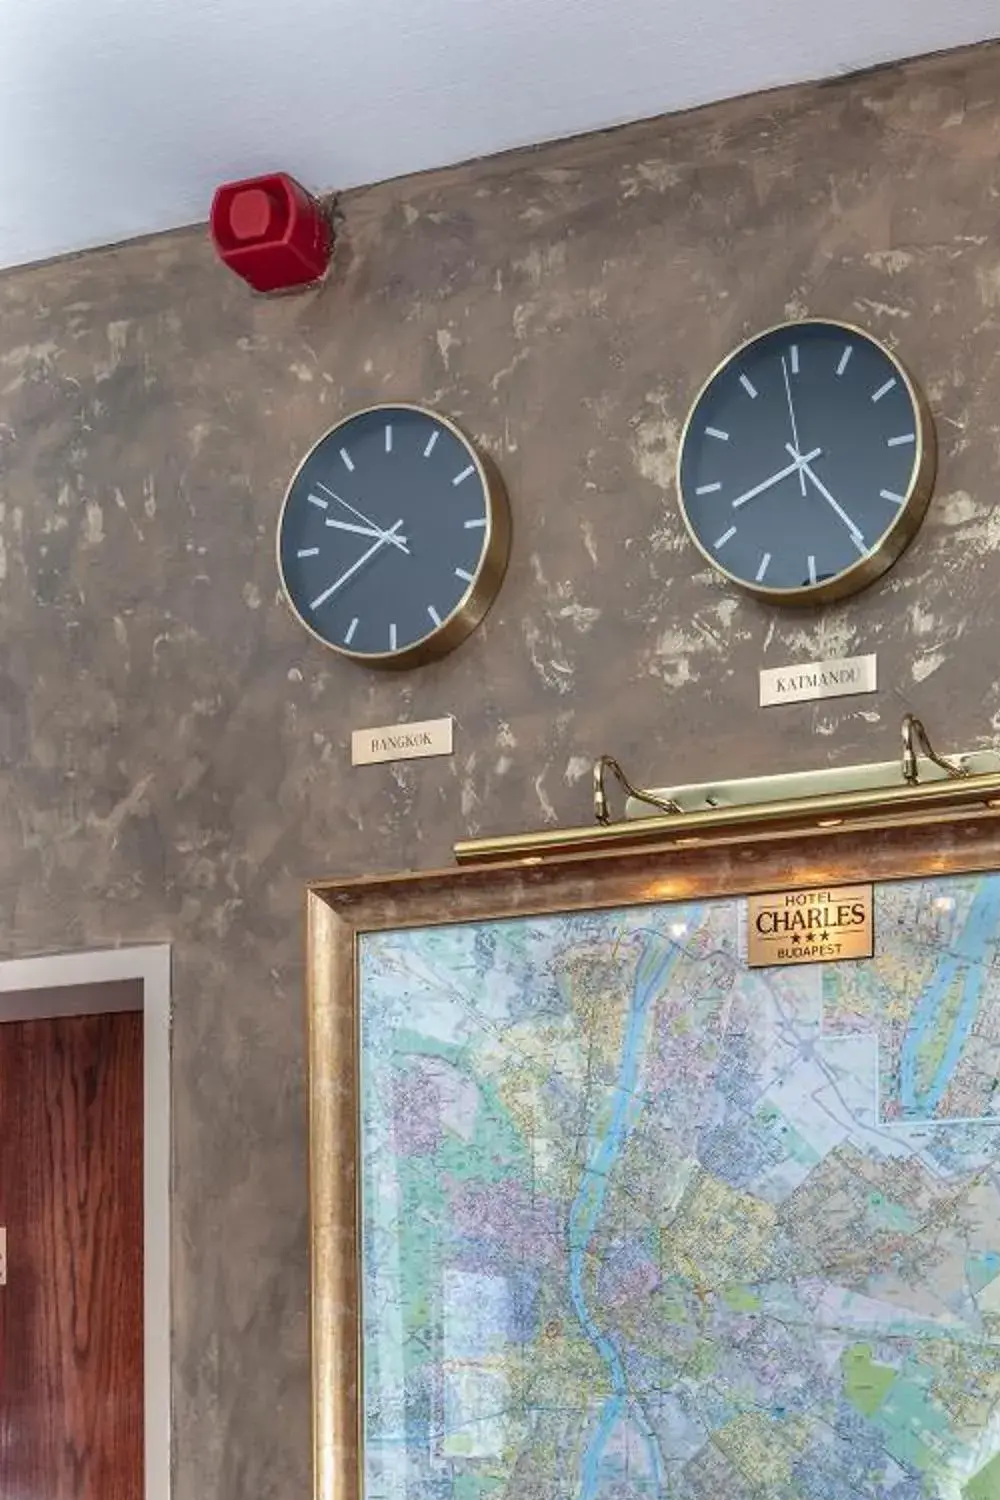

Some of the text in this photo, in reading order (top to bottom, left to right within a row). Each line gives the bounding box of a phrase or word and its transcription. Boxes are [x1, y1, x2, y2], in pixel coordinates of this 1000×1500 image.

[776, 666, 861, 693] KATMANDU
[371, 731, 433, 752] BANGKOK
[785, 891, 832, 907] HOTEL
[756, 903, 866, 933] CHARLES
[777, 943, 843, 959] BUDAPEST
